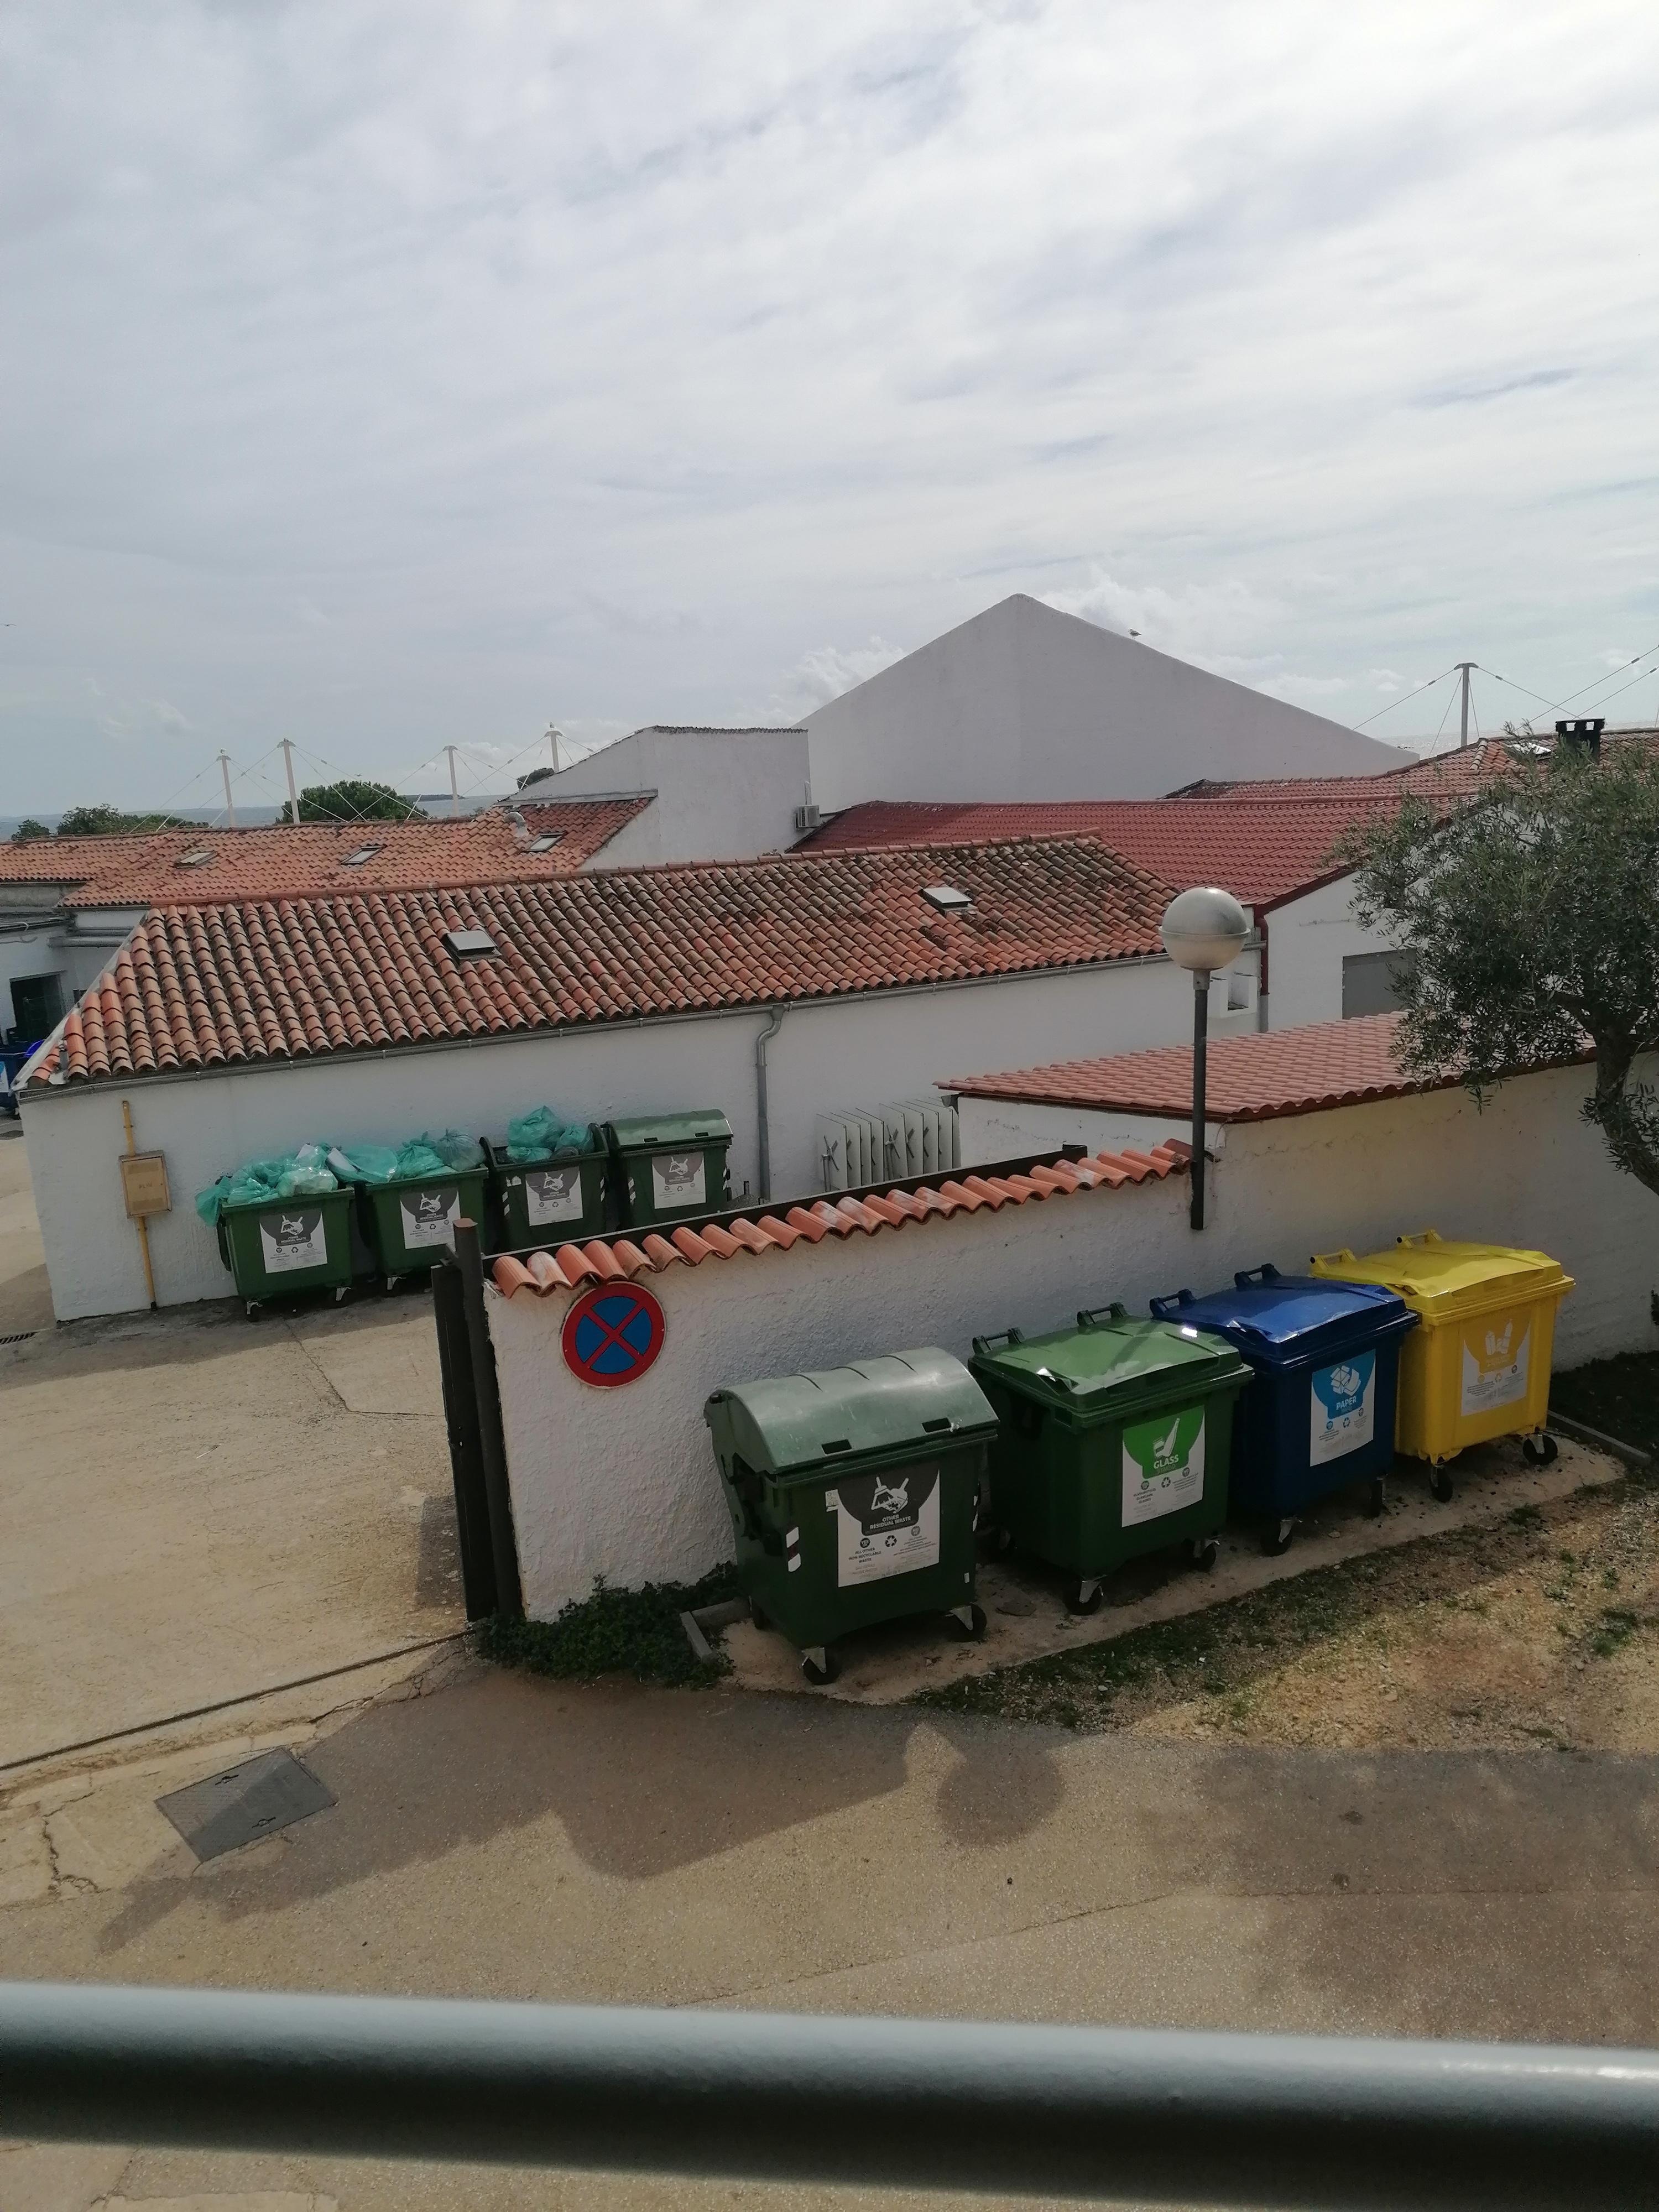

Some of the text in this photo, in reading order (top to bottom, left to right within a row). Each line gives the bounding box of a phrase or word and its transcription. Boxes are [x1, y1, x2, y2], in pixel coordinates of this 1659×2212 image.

[1336, 1396, 1357, 1410] PAPER
[1154, 1454, 1179, 1469] GLASS
[870, 1516, 911, 1529] RESIDUAL WASTE
